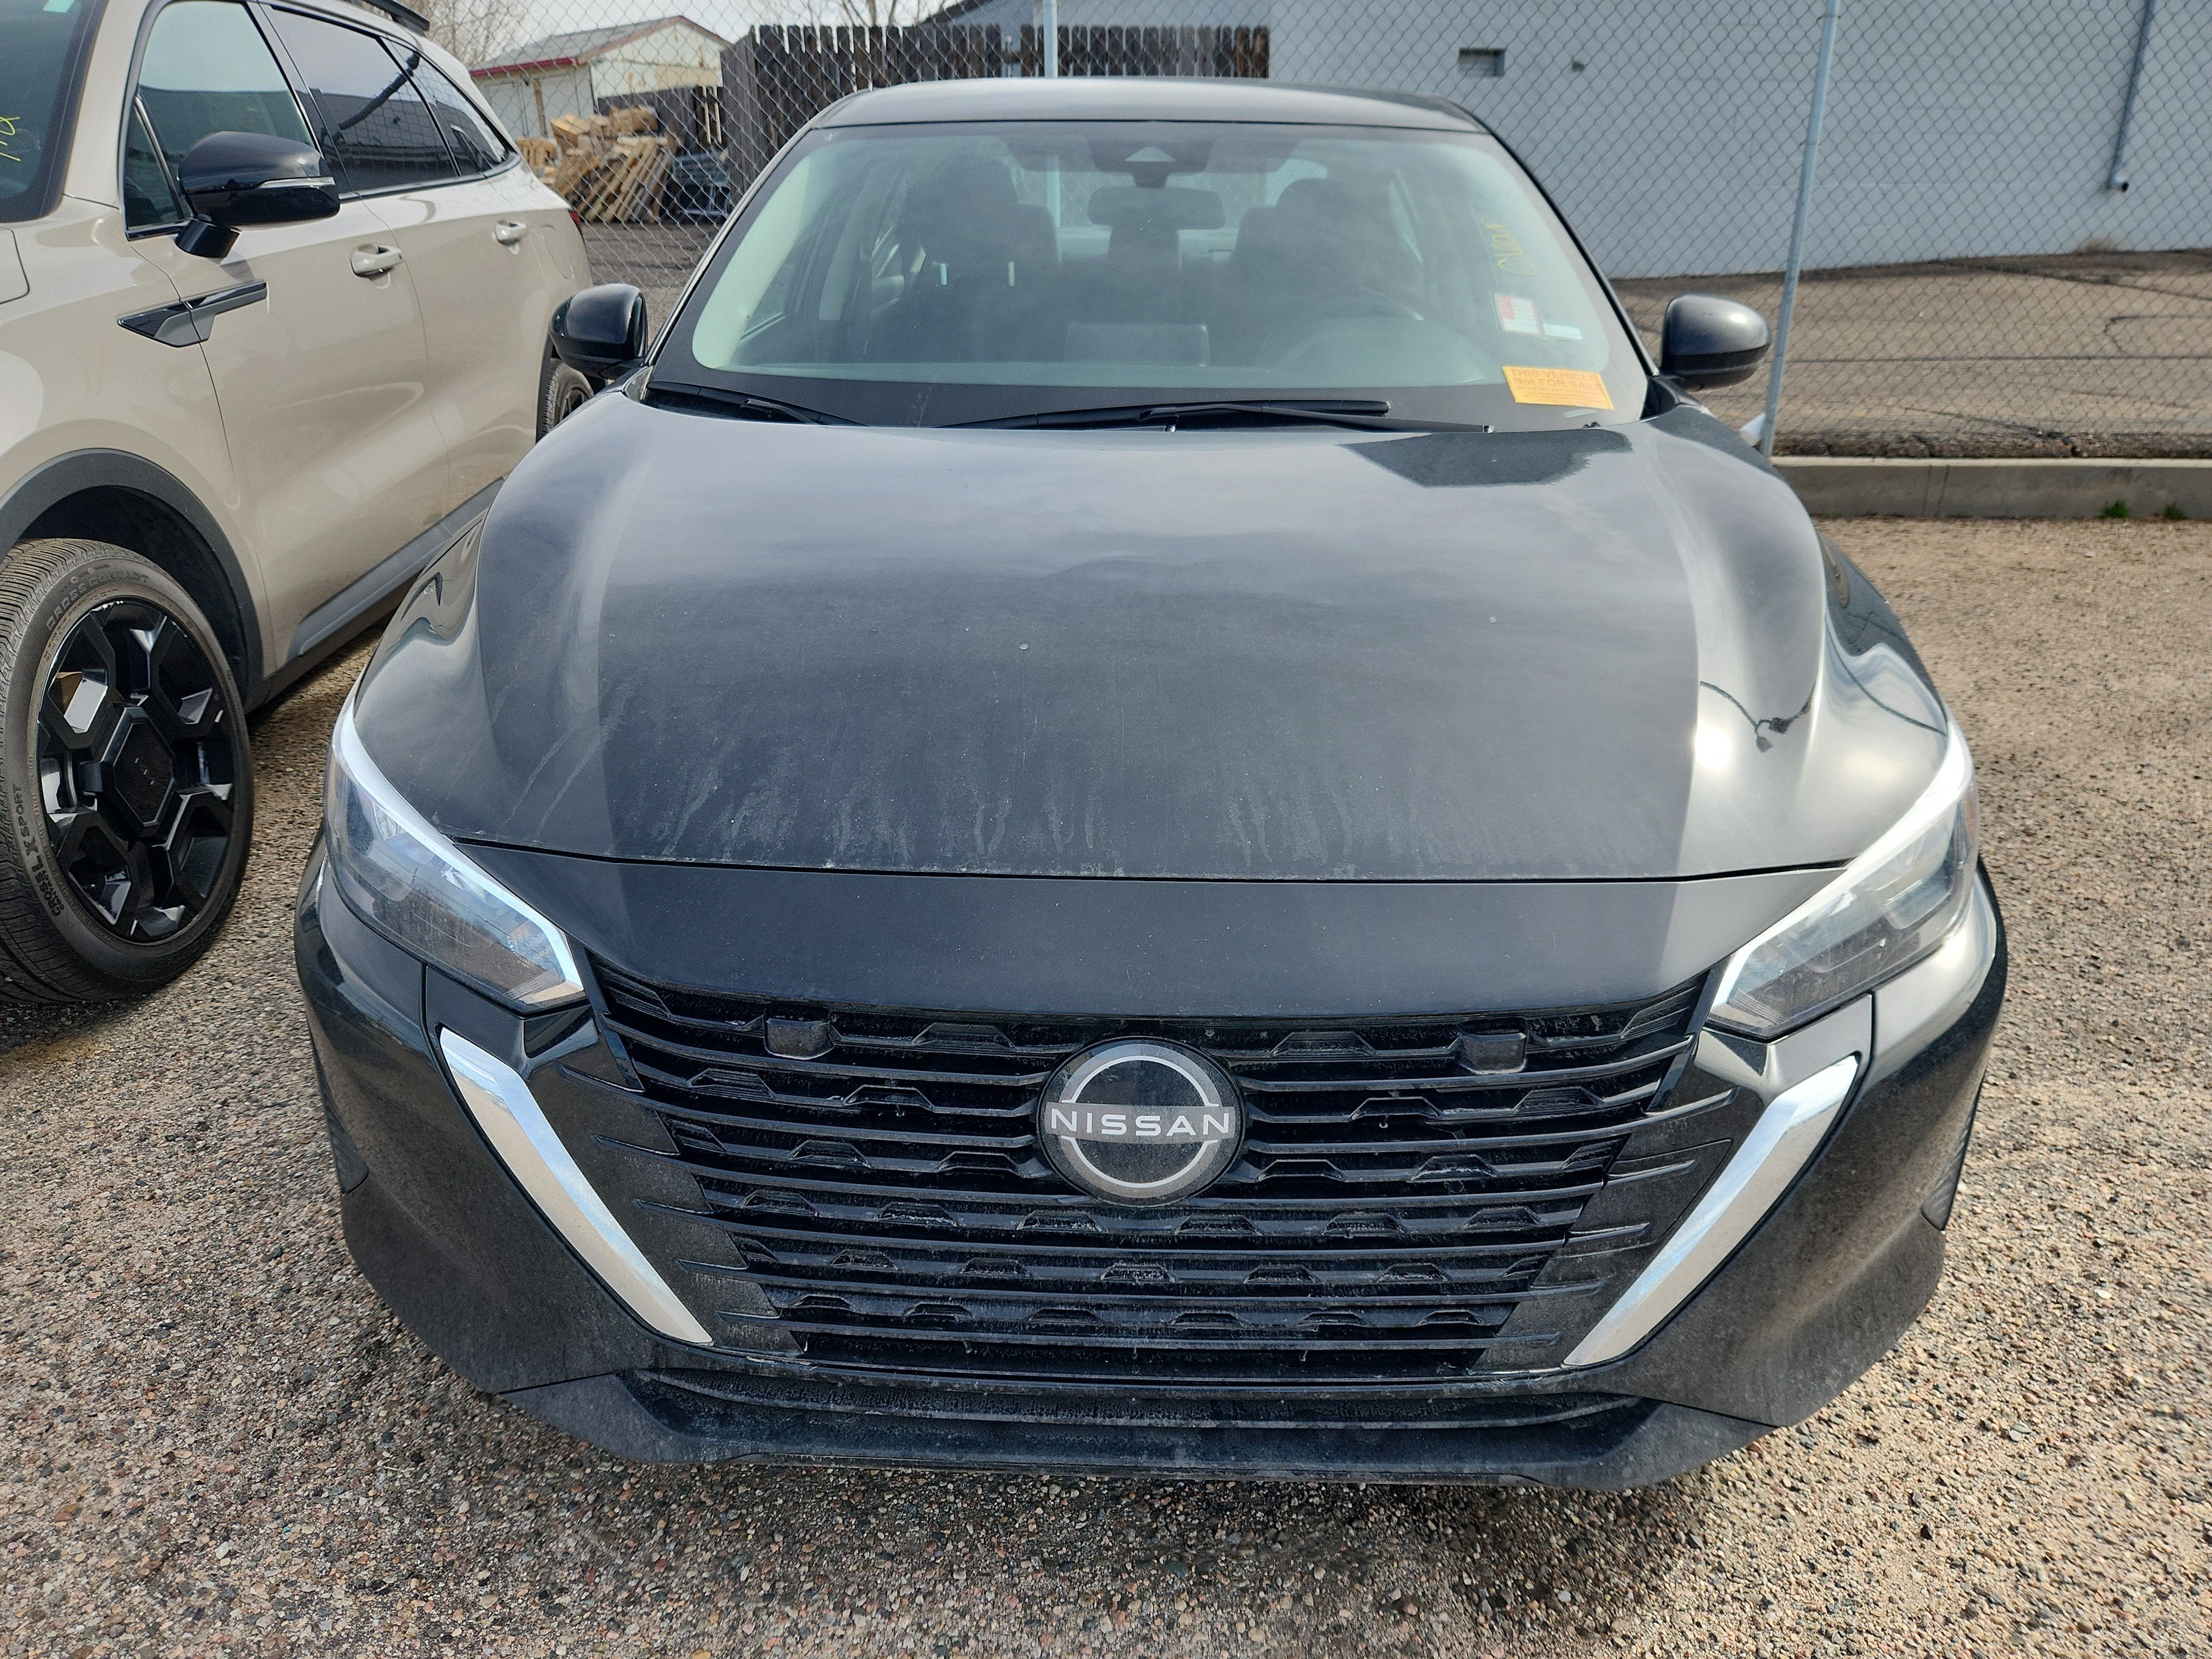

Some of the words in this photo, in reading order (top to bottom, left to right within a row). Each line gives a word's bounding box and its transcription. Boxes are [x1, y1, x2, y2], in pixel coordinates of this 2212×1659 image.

[1511, 369, 1539, 377] THIS
[1543, 370, 1597, 380] VEHICLE
[1539, 379, 1566, 387] FOR
[1571, 381, 1603, 389] SALE
[46, 583, 87, 631] CROSS
[12, 783, 30, 838] SPORT
[35, 871, 61, 917] CROSS
[42, 870, 65, 910] CONTACT
[1051, 1108, 1229, 1136] NISSAN
